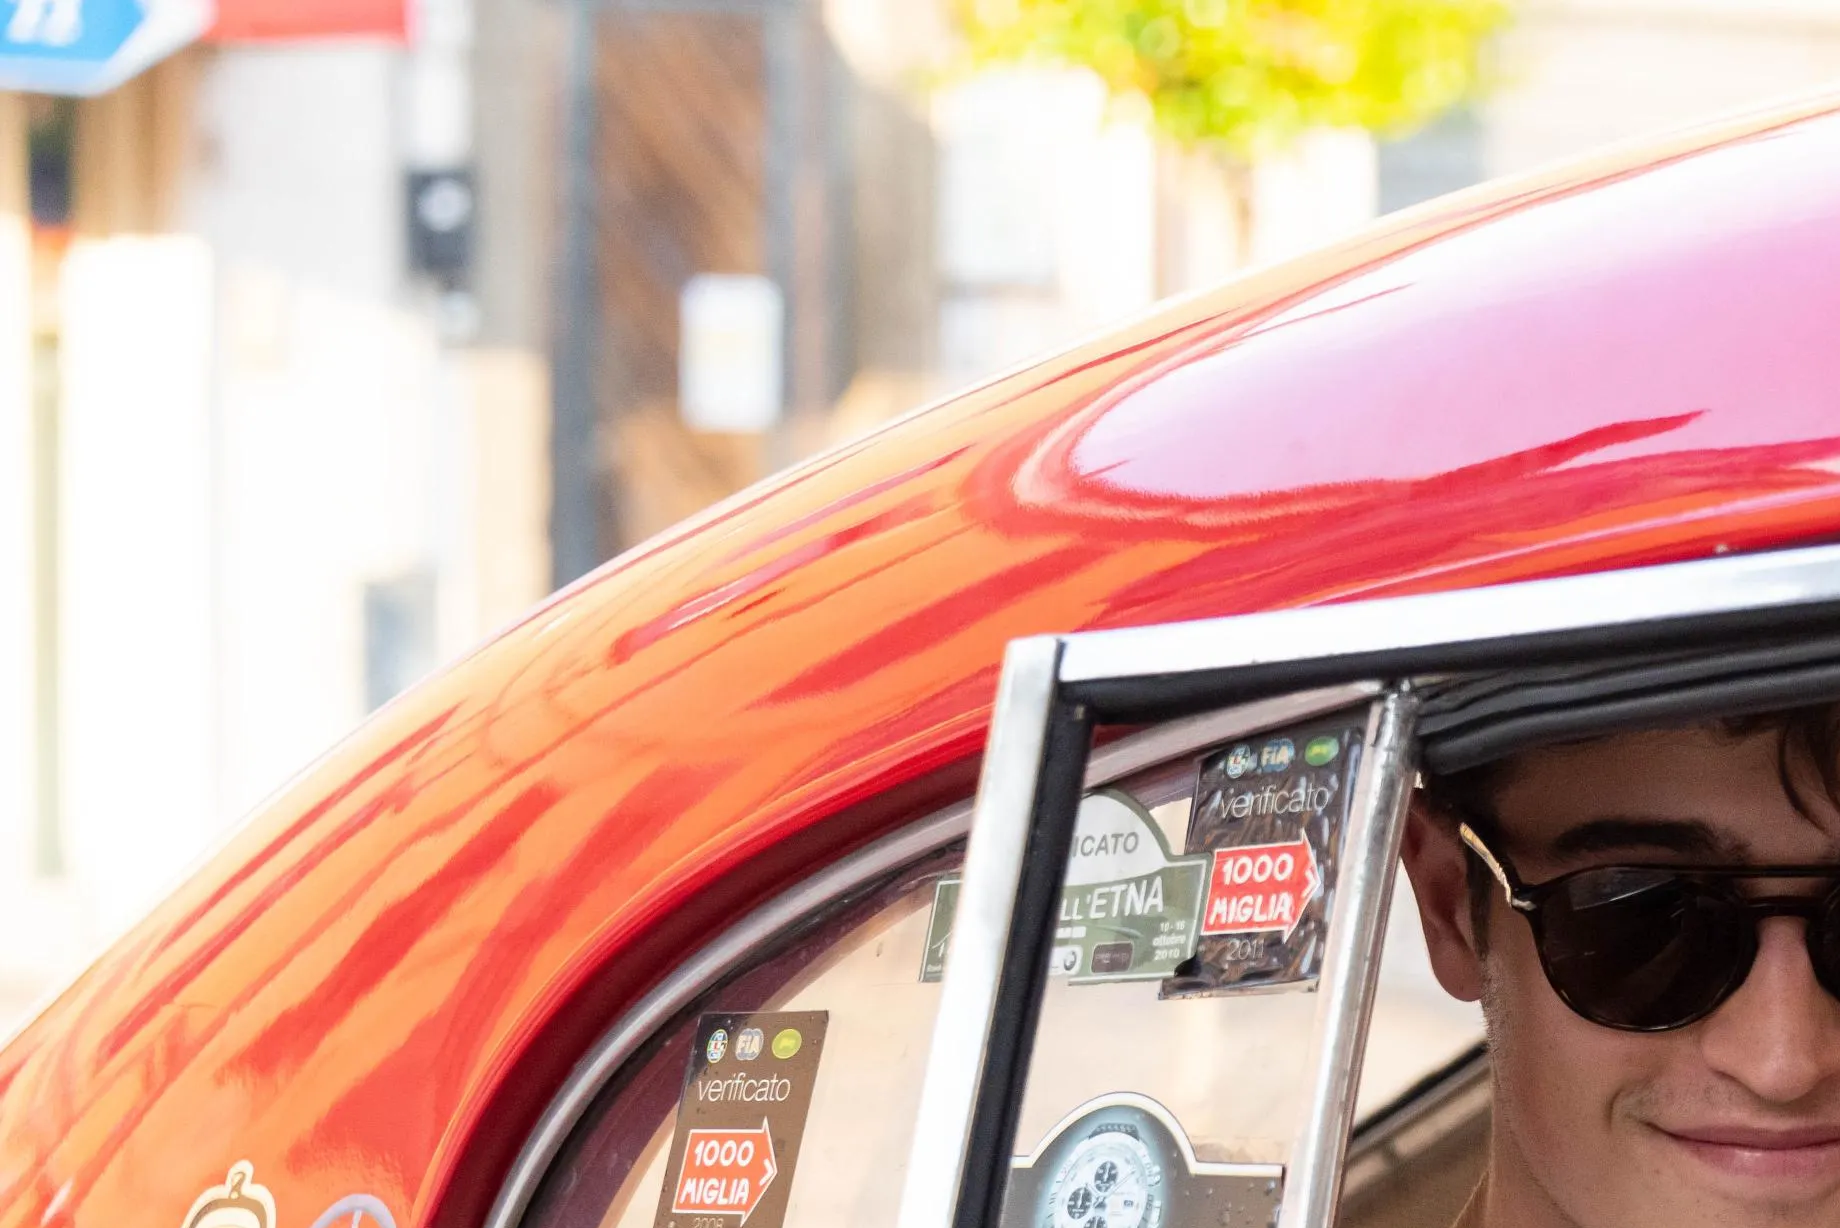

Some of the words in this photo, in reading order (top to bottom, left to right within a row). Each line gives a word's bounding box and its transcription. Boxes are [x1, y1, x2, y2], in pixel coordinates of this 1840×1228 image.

[1220, 783, 1330, 819] verificato
[1071, 831, 1139, 858] ICATO
[1222, 853, 1294, 886] 1000
[1059, 876, 1165, 921] LL'ETNA
[1209, 891, 1293, 927] MIGLIA
[1226, 938, 1266, 963] 2011
[698, 1072, 791, 1101] verificato
[694, 1140, 754, 1167] 1000
[679, 1177, 751, 1205] MIGLIA
